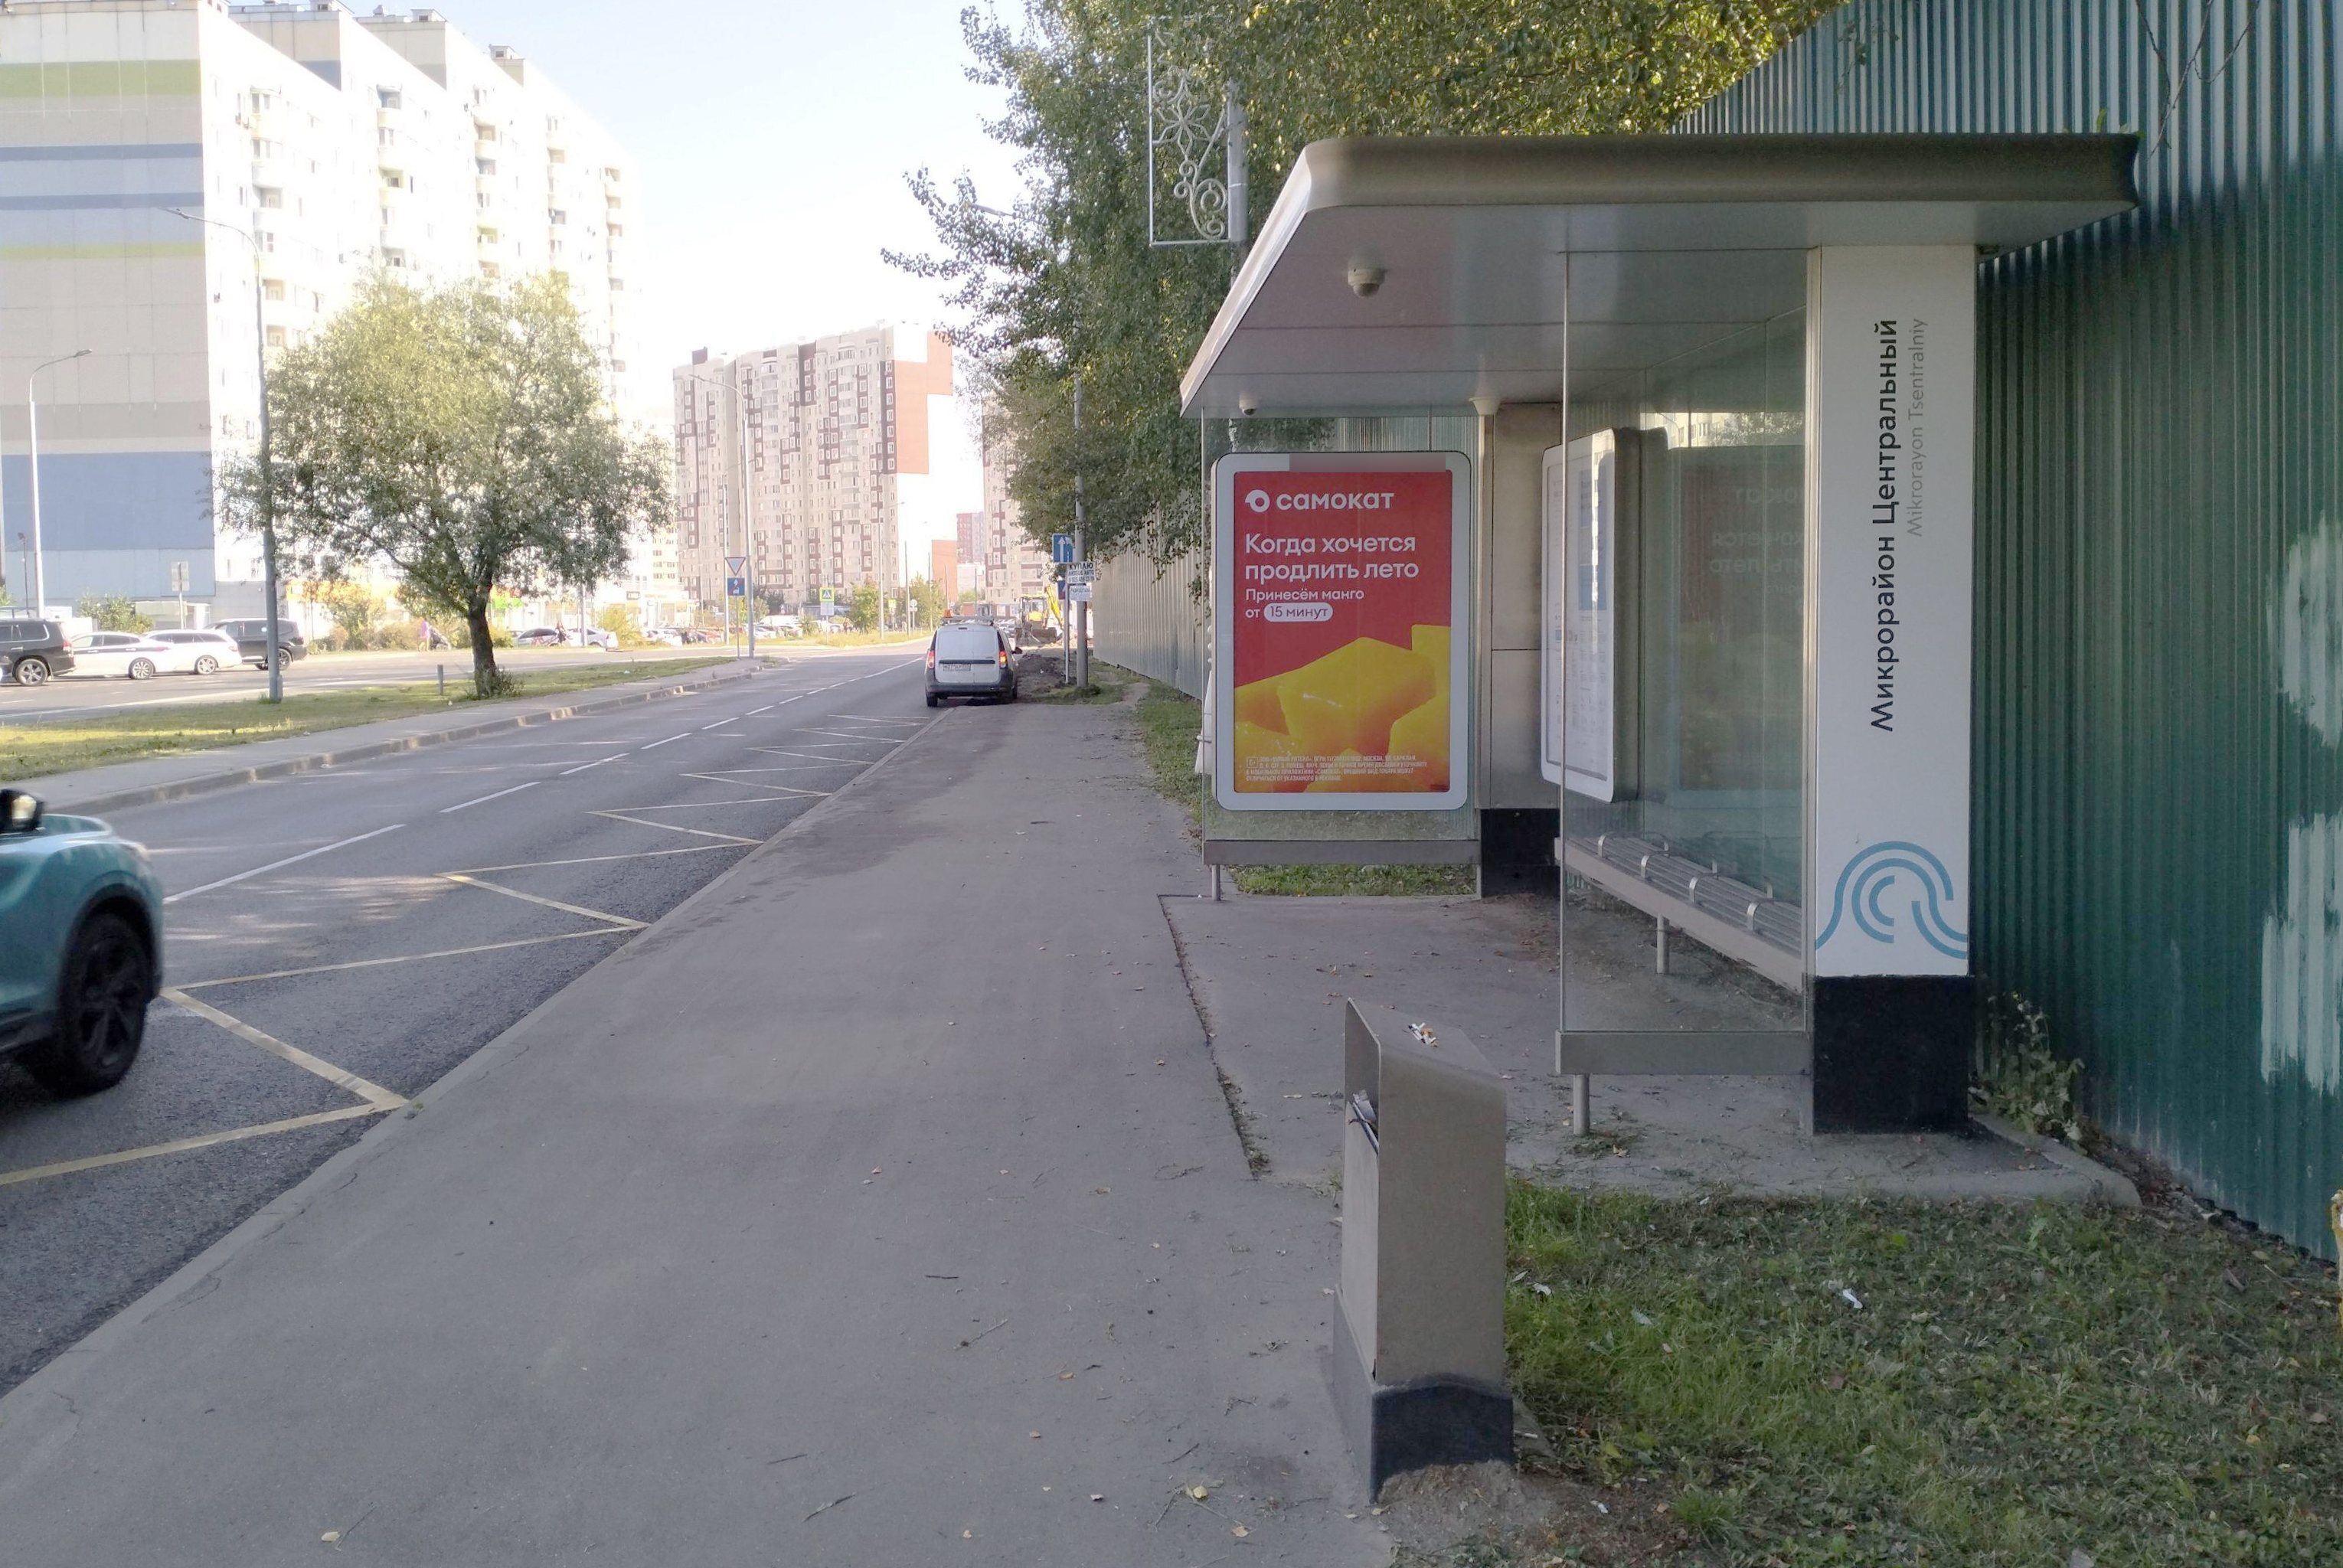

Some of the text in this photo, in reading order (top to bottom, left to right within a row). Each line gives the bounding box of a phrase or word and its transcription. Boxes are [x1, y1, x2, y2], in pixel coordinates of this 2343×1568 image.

[1907, 318, 1929, 537] Mikrorayon Tsentralniy
[1276, 492, 1394, 511] самокат
[1871, 319, 1901, 732] Микрорайон Центральный
[1245, 533, 1416, 556] Когда хочется
[1245, 562, 1420, 585] продлить лето
[1245, 588, 1364, 603] Принесём манго
[1245, 606, 1328, 619] от 15 минут
